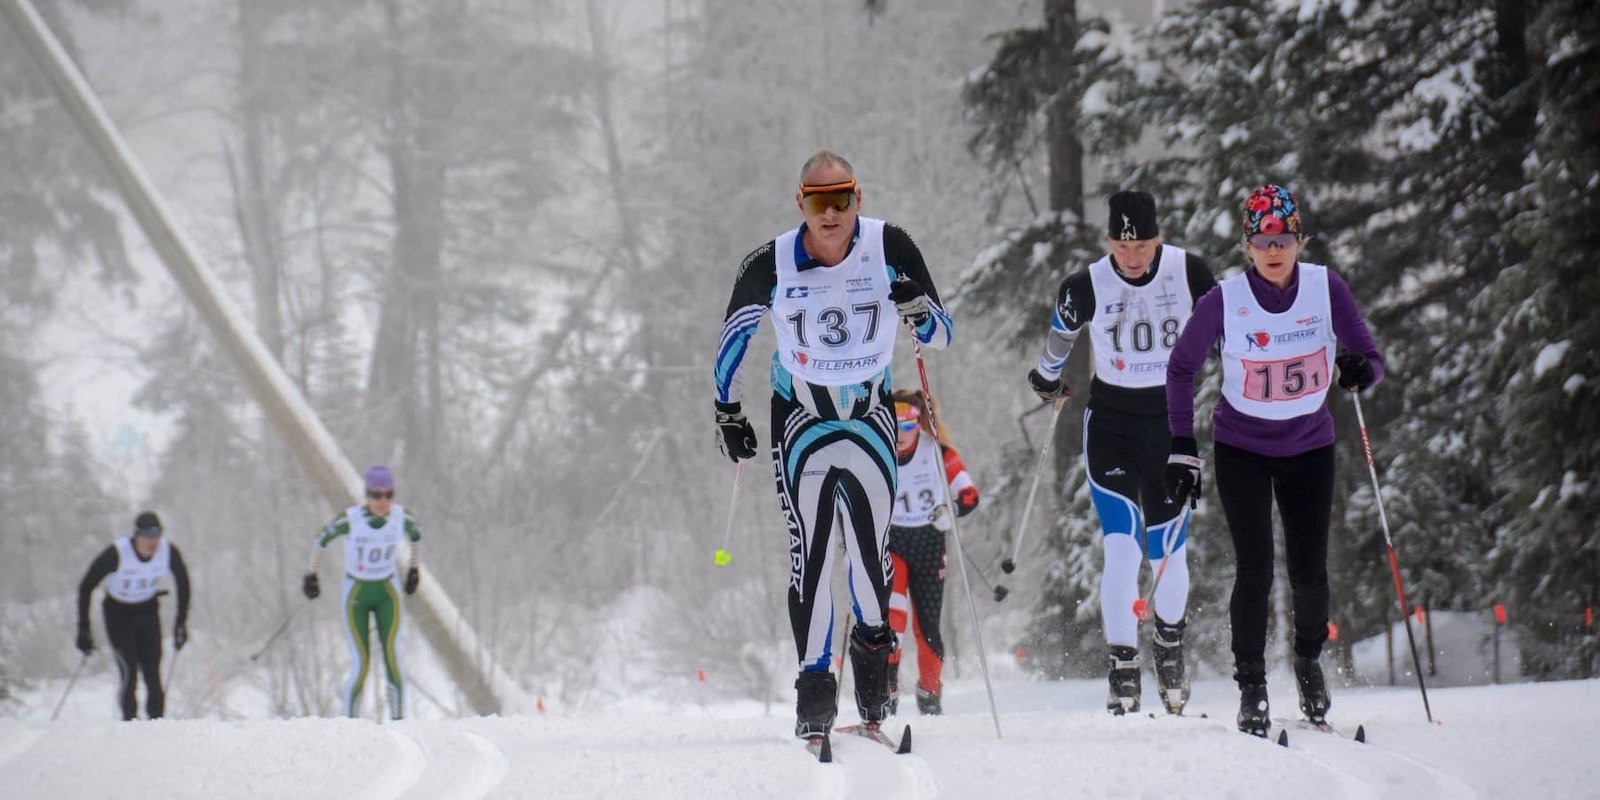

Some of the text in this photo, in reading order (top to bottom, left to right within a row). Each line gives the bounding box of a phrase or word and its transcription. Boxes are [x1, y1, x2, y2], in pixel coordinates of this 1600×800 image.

[786, 300, 881, 348] 137
[1106, 316, 1179, 353] 108
[1273, 327, 1319, 344] TELEMARK
[812, 354, 880, 371] TELEMARK
[1129, 360, 1168, 373] TELEMA
[1253, 358, 1306, 401] 15
[771, 442, 805, 602] TELEMARK
